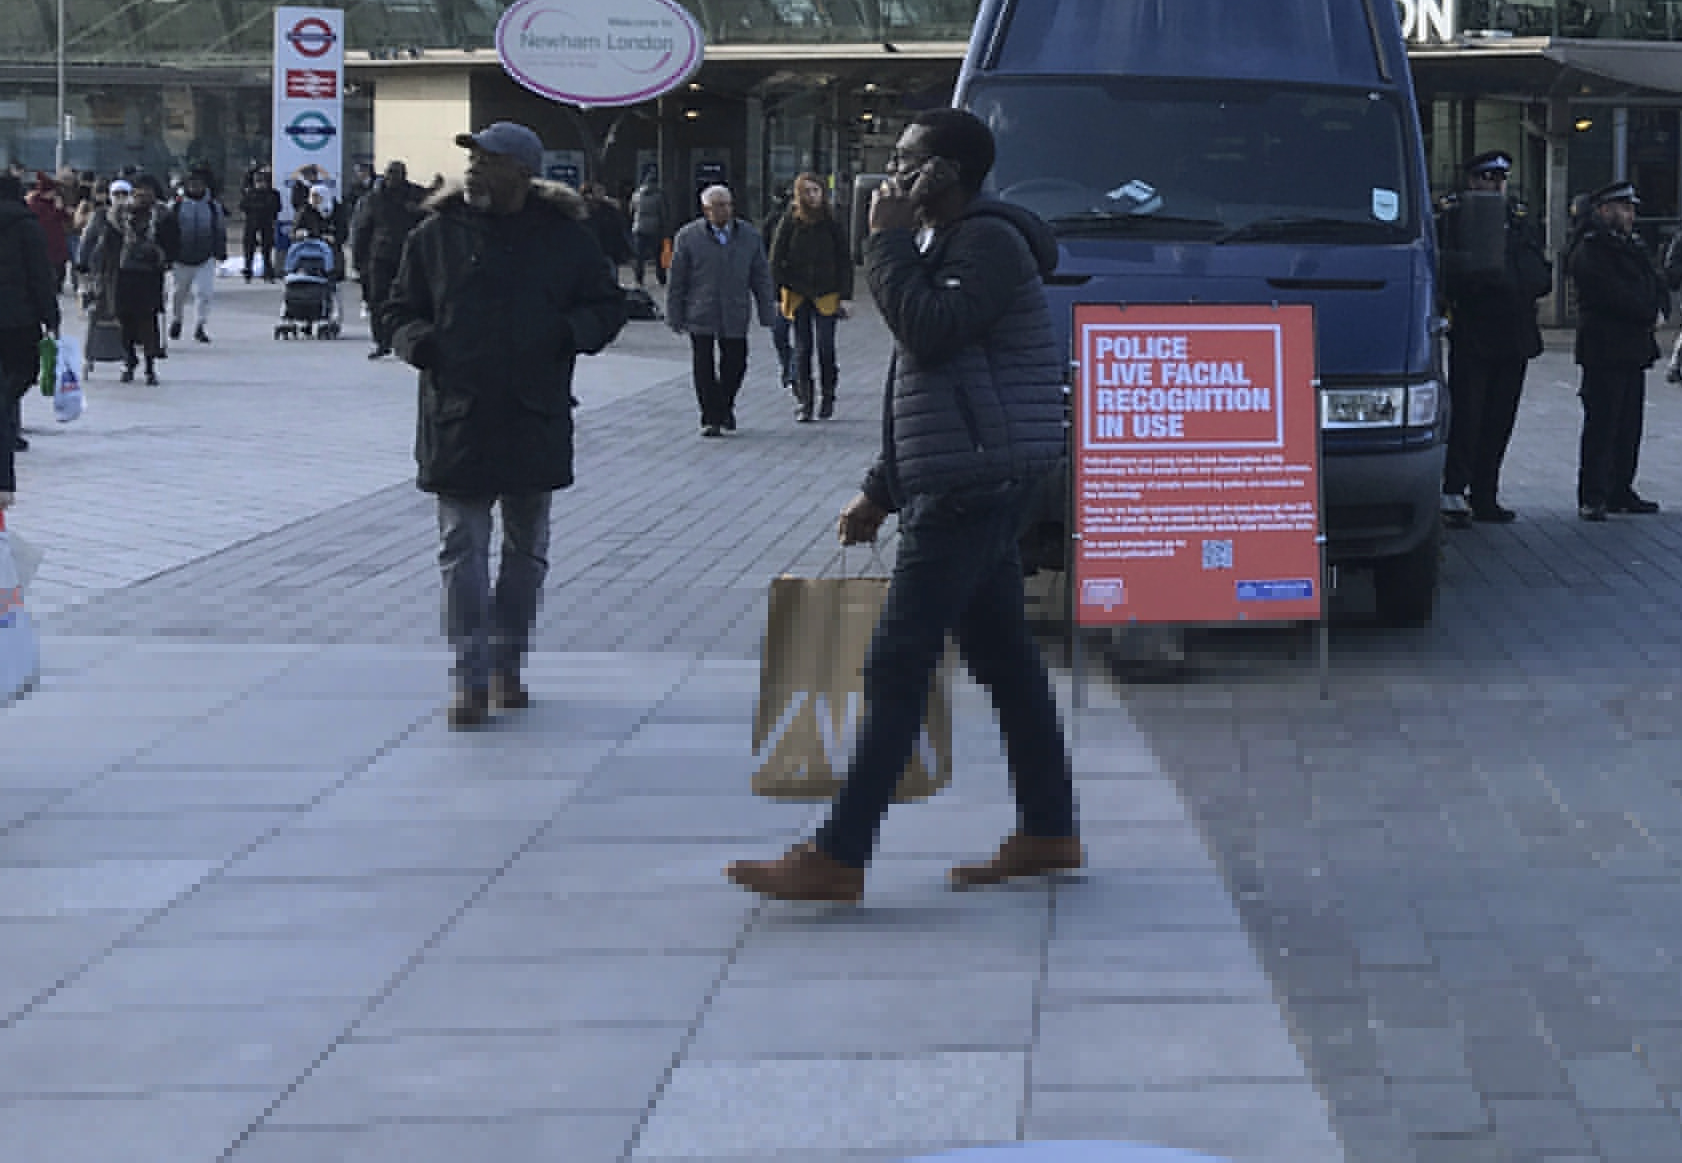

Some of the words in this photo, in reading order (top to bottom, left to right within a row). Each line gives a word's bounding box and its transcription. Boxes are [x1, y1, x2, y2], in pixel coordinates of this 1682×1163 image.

[520, 32, 600, 50] Newham
[607, 32, 673, 51] London
[1095, 336, 1189, 360] POLICE
[1095, 362, 1153, 386] LIVE
[1160, 360, 1252, 386] FACIAL
[1095, 386, 1273, 412] RECOGNITION
[1095, 414, 1124, 439] IN
[1132, 412, 1186, 438] USE
